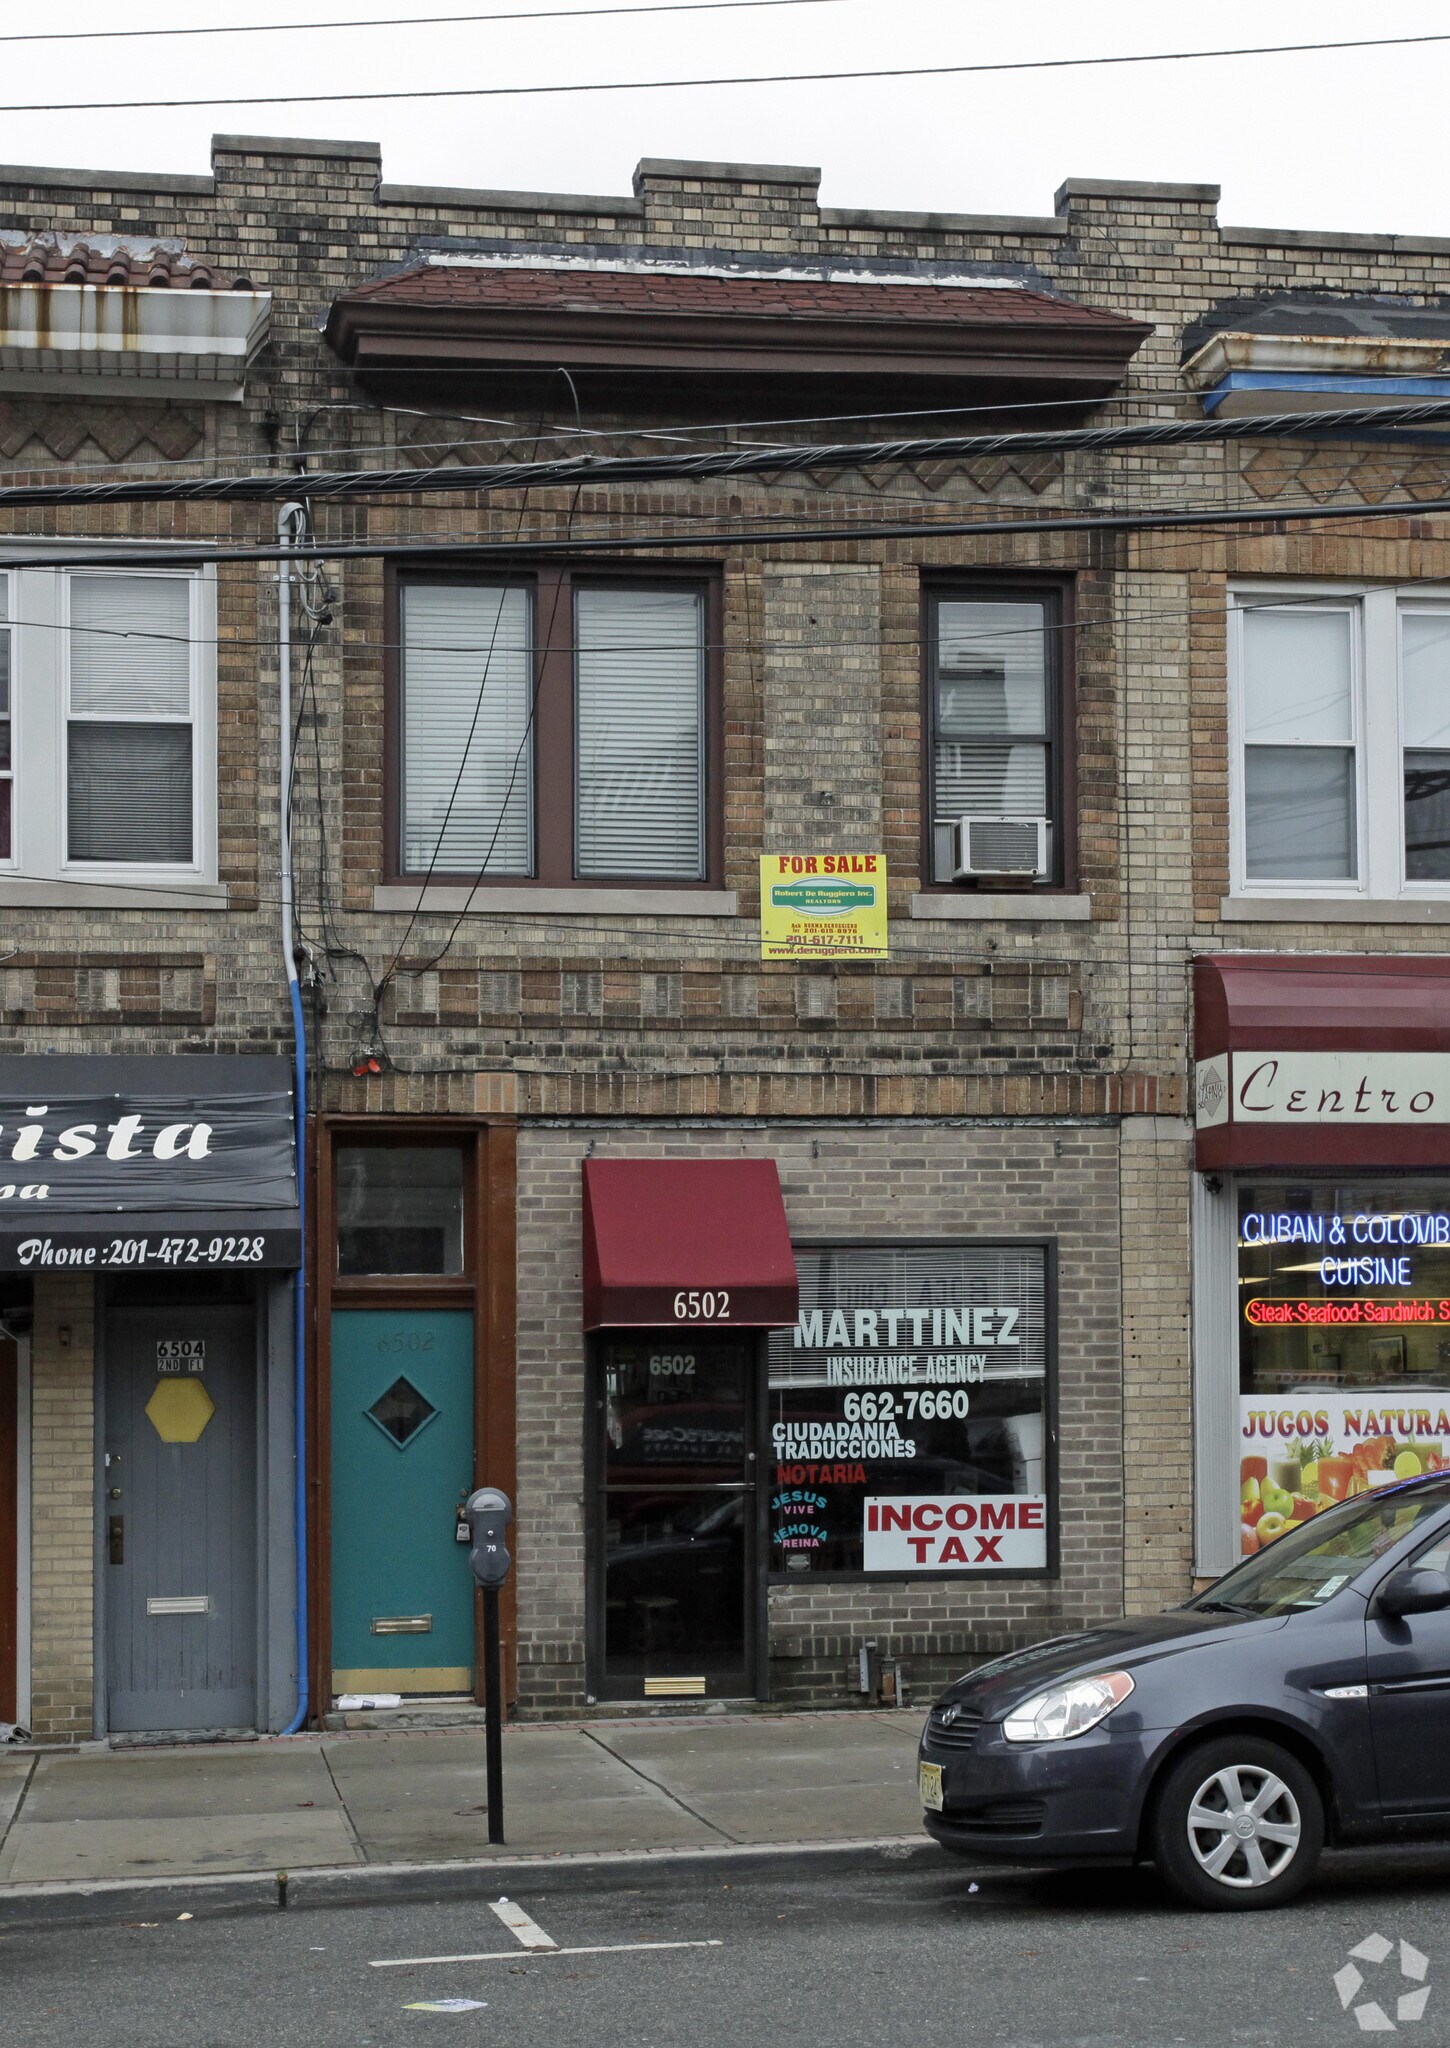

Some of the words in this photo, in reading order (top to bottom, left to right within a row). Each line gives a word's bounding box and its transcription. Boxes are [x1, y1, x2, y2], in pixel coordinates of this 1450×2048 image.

[779, 856, 818, 874] FOR
[823, 855, 877, 873] SALE
[817, 890, 855, 898] Ruggiero
[1240, 1060, 1434, 1114] Centro
[0, 1105, 213, 1162] ista
[1243, 1213, 1323, 1244] CUBAN
[1328, 1215, 1347, 1245] &
[1352, 1214, 1450, 1245] COLOMB
[1320, 1256, 1412, 1286] CUISINE
[673, 1291, 731, 1319] 6502
[794, 1307, 1020, 1348] MARTTINEZ
[157, 1340, 205, 1357] 6504
[158, 1359, 180, 1371] 2ND
[188, 1359, 203, 1371] FL
[649, 1354, 696, 1376] 6502
[826, 1355, 918, 1386] INSURANCE
[925, 1354, 988, 1384] AGENCY
[843, 1389, 970, 1422] 662-7660
[772, 1421, 900, 1442] CIUDADANIA
[1242, 1409, 1330, 1438] JUGOS
[1342, 1408, 1450, 1438] NATURA
[773, 1439, 916, 1460] TRADUCCIONES
[776, 1463, 867, 1485] NOTARIA
[771, 1490, 828, 1510] JESUS
[784, 1505, 814, 1514] VIVE
[867, 1502, 1045, 1532] INCOME
[773, 1523, 828, 1544] JEHOVA
[783, 1538, 820, 1548] REINA
[907, 1535, 1005, 1564] TAX
